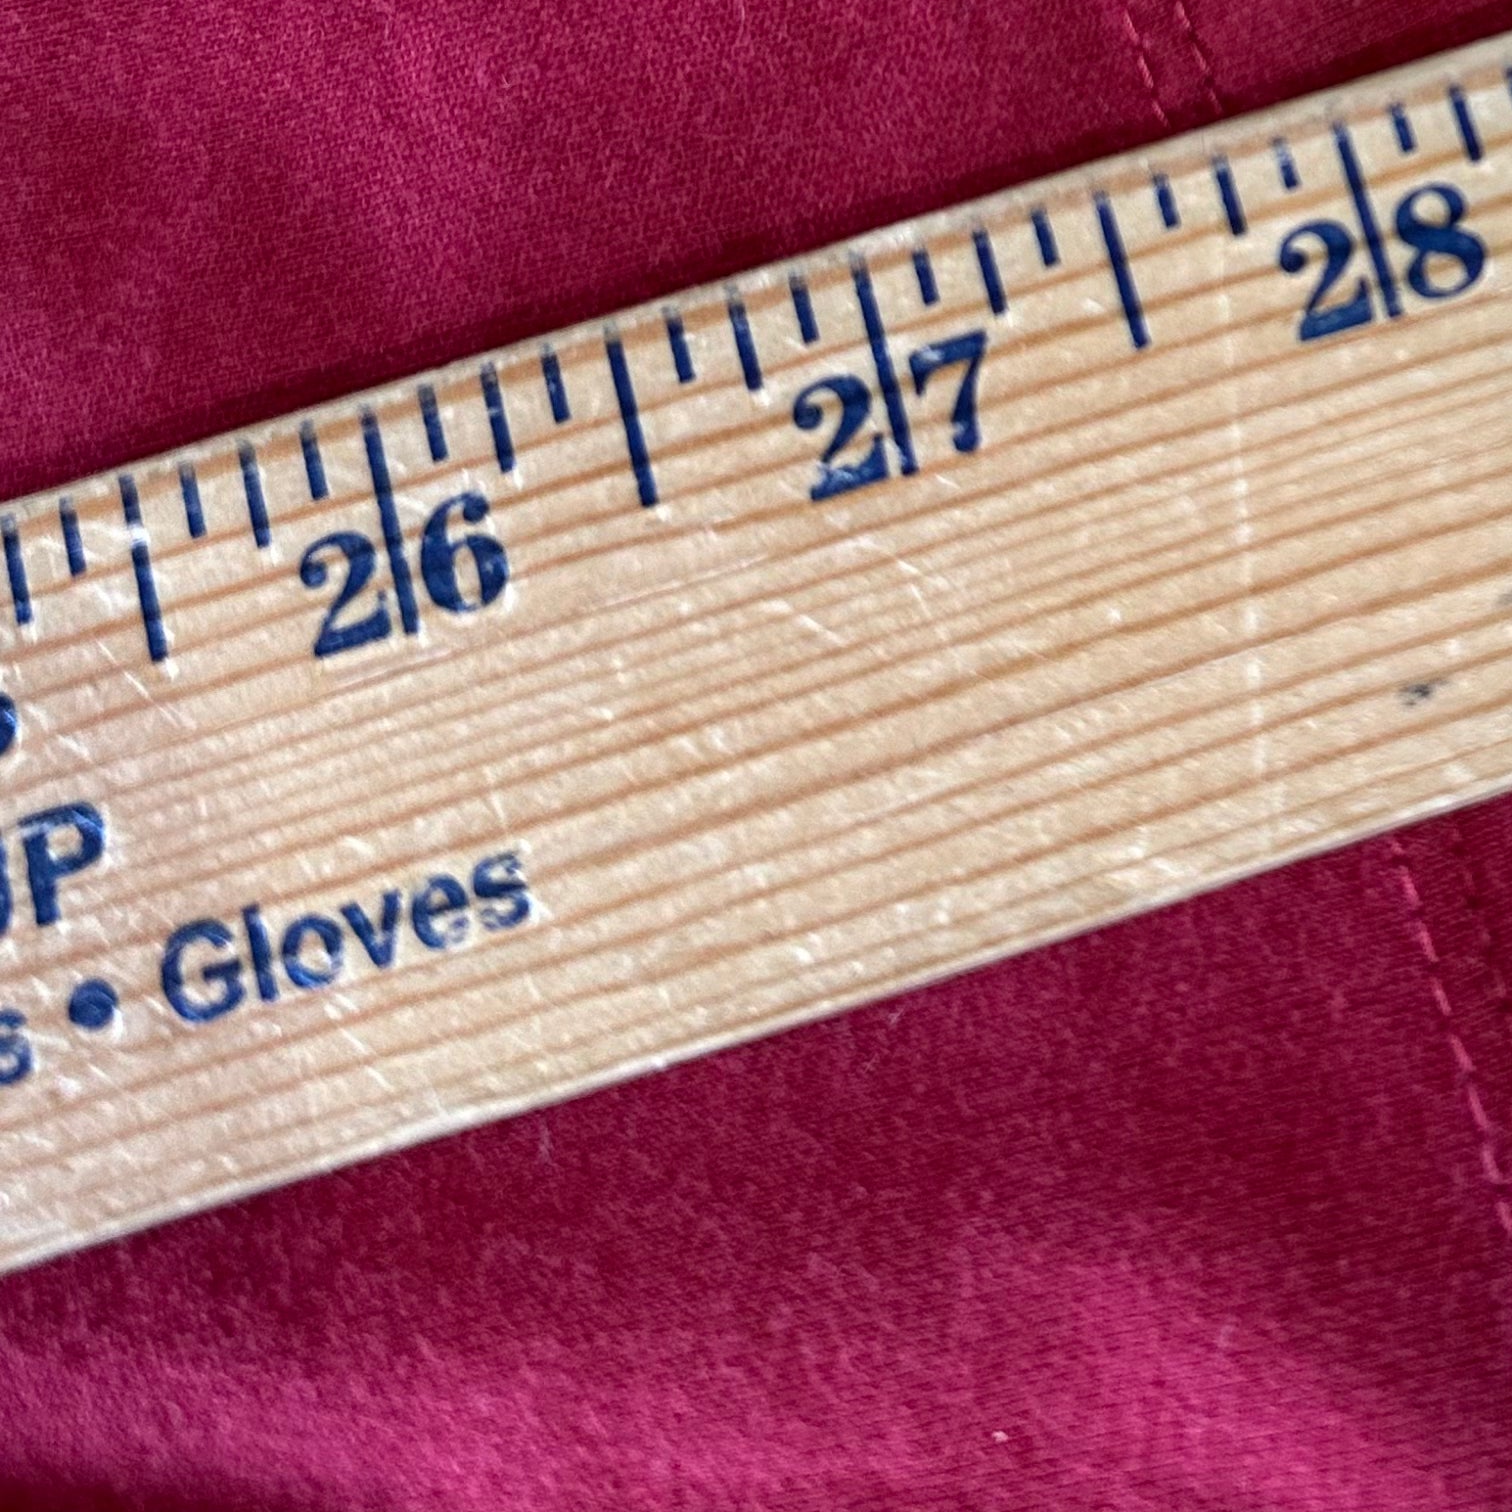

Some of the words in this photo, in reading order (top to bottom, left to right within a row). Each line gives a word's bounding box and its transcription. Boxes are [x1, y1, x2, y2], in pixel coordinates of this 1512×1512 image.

[1277, 182, 1487, 342] 28
[791, 330, 989, 502] 27
[300, 490, 510, 658] 26
[160, 850, 533, 1024] Gloves
